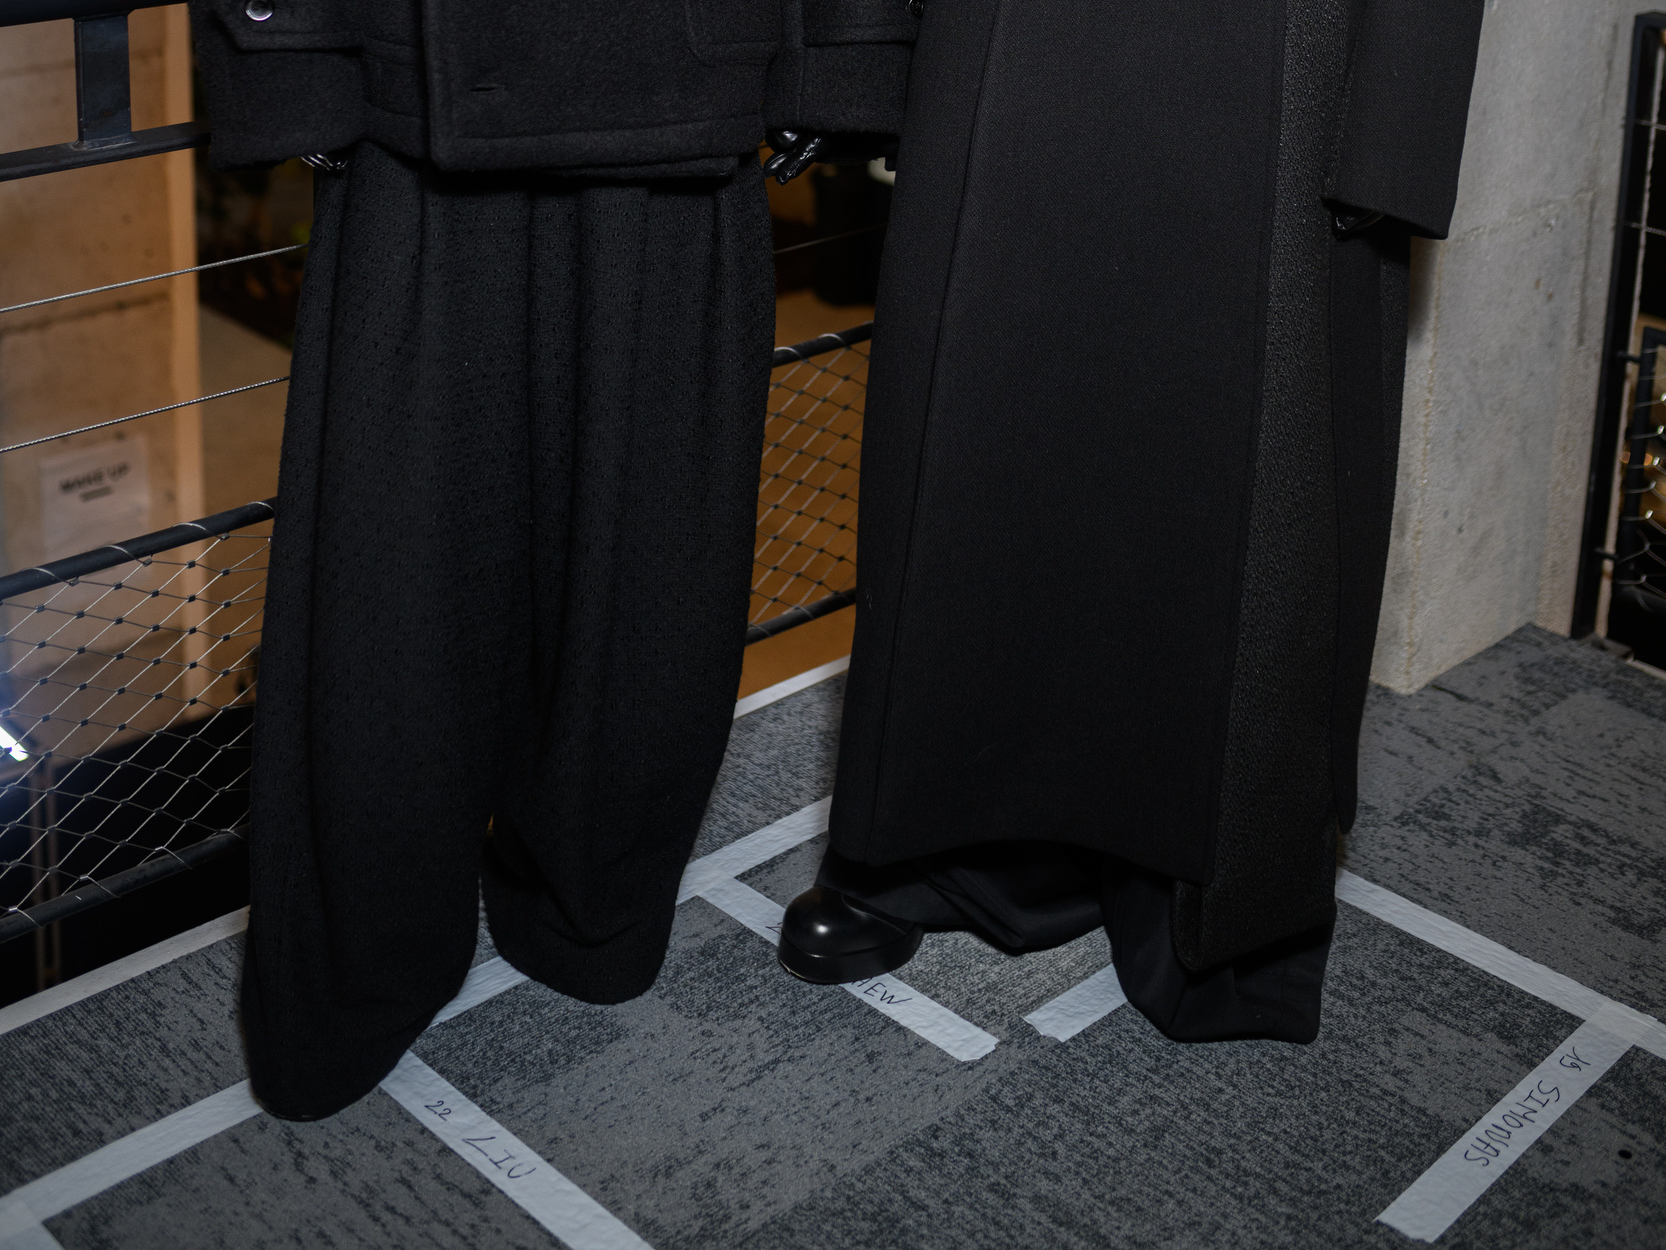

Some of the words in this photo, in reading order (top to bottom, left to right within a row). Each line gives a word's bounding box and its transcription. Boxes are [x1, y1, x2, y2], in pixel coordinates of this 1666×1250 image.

[424, 1100, 452, 1122] 22
[461, 1136, 537, 1179] LIU
[1463, 1079, 1561, 1167] SIMONAS
